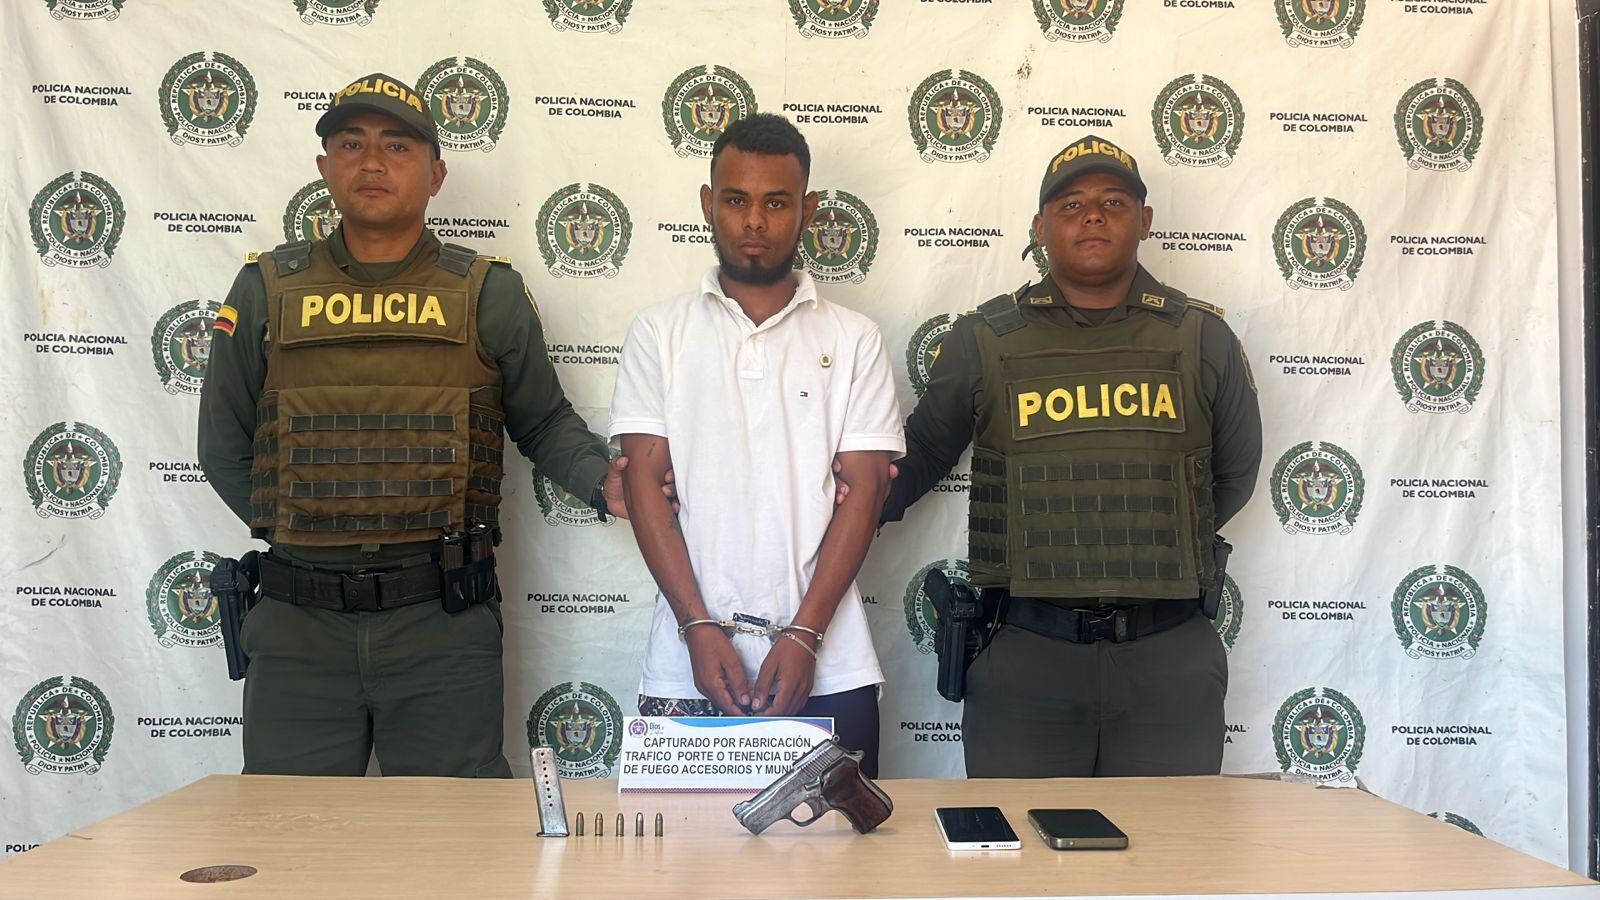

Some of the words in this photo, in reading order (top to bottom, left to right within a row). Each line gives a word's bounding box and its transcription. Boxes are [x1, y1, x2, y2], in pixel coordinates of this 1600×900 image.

[1164, 0, 1177, 8] DE
[1180, 0, 1234, 8] COLOMBIA
[1420, 6, 1473, 14] COLOMBIA
[33, 84, 72, 93] POLICIA
[75, 86, 132, 94] NACIONAL
[284, 92, 326, 101] POLICIA
[334, 79, 423, 112] POLICIA
[44, 96, 56, 104] DE
[59, 96, 118, 106] COLOMBIA
[580, 98, 636, 108] NACIONAL
[969, 85, 991, 121] COLOMBIA
[298, 103, 312, 111] DE
[783, 104, 824, 112] POLICIA
[827, 105, 882, 113] NACIONAL
[1028, 107, 1069, 115] POLICIA
[1072, 108, 1126, 116] NACIONAL
[565, 108, 622, 118] COLOMBIA
[1270, 113, 1310, 121] POLICIA
[1313, 114, 1368, 122] NACIONAL
[797, 115, 811, 123] DE
[1042, 118, 1055, 126] DE
[1058, 118, 1112, 127] COLOMBIA
[1299, 124, 1354, 132] COLOMBIA
[923, 130, 946, 150] POLICIA
[955, 130, 987, 151] NACIONAL
[955, 150, 979, 160] PATRIA
[1052, 141, 1133, 173] POLICIA
[154, 213, 197, 221] POLICIA
[200, 213, 256, 222] NACIONAL
[598, 199, 620, 236] COLOMBIA
[424, 218, 450, 226] ICIA
[453, 218, 509, 227] NACIONAL
[168, 224, 182, 232] DE
[186, 225, 242, 233] COLOMBIA
[658, 224, 700, 232] POLICIA
[905, 228, 946, 236] POLICIA
[949, 228, 1003, 236] NACIONAL
[1334, 212, 1355, 249] COLOMBIA
[438, 229, 495, 238] COLOMBIA
[1149, 231, 1190, 240] POLICIA
[1192, 232, 1246, 240] NACIONAL
[918, 239, 932, 247] DE
[934, 239, 990, 247] COLOMBIA
[1391, 236, 1428, 244] POLICIA
[1431, 236, 1486, 244] NACIONAL
[1162, 242, 1176, 250] DE
[1178, 242, 1232, 251] COLOMBIA
[1402, 247, 1414, 255] DE
[1417, 247, 1473, 255] COLOMBIA
[553, 245, 576, 265] POLICIA
[585, 245, 616, 267] NACIONAL
[584, 265, 608, 276] PATRIA
[1289, 257, 1312, 277] POLICIA
[1320, 257, 1351, 279] NACIONAL
[1320, 277, 1343, 288] PATRIA
[301, 292, 447, 328] POLICIA
[24, 334, 66, 342] POLICIA
[69, 335, 128, 344] NACIONAL
[52, 345, 114, 355] COLOMBIA
[547, 344, 574, 352] LICIA
[577, 345, 623, 353] NACION
[562, 356, 619, 364] COLOMBIA
[1313, 356, 1364, 364] NACIONAL
[1299, 367, 1351, 375] COLOMBIA
[1018, 383, 1177, 427] POLICIA
[150, 462, 191, 471] POLICIA
[164, 474, 177, 482] DE
[180, 474, 207, 482] COLO
[1391, 479, 1429, 487] POLICIA
[932, 484, 970, 493] COLOM
[1418, 490, 1475, 498] COLOMBIA
[17, 587, 61, 595] POLICIA
[64, 587, 116, 596] NACIONAL
[527, 593, 570, 602] POLICIA
[573, 594, 629, 602] NACIONAL
[1454, 580, 1475, 617] COLOMBIA
[32, 598, 46, 606] DE
[49, 598, 102, 608] COLOMBIA
[541, 605, 555, 613] DE
[558, 605, 615, 613] COLOMBIA
[1282, 612, 1296, 620] DE
[1299, 612, 1353, 620] COLOMBIA
[1408, 625, 1434, 647] POLICIA
[1442, 626, 1472, 647] NACIONAL
[1442, 646, 1465, 657] PATRIA
[81, 692, 102, 731] COLOMBIA
[138, 718, 182, 726] POLICIA
[900, 722, 943, 730] POLICIA
[169, 728, 231, 737] COLOMBIA
[1392, 726, 1434, 734] POLICIA
[1436, 726, 1492, 734] NACIONAL
[643, 737, 710, 748] CAPTURADO
[713, 737, 736, 748] POR
[915, 734, 928, 742] DE
[931, 734, 962, 742] COLO
[1422, 737, 1477, 745] COLOMBIA
[31, 740, 56, 761] POLICIA
[65, 740, 99, 762] NACIONAL
[625, 751, 672, 761] TRAFICO
[677, 751, 714, 761] PORTE
[716, 751, 725, 761] O
[728, 751, 782, 761] TENENCIA
[784, 751, 798, 761] DE
[65, 761, 89, 772] PATRIA
[623, 765, 638, 775] DE
[641, 764, 679, 775] FUEGO
[681, 764, 752, 775] ACCESORIOS
[755, 765, 763, 775] Y
